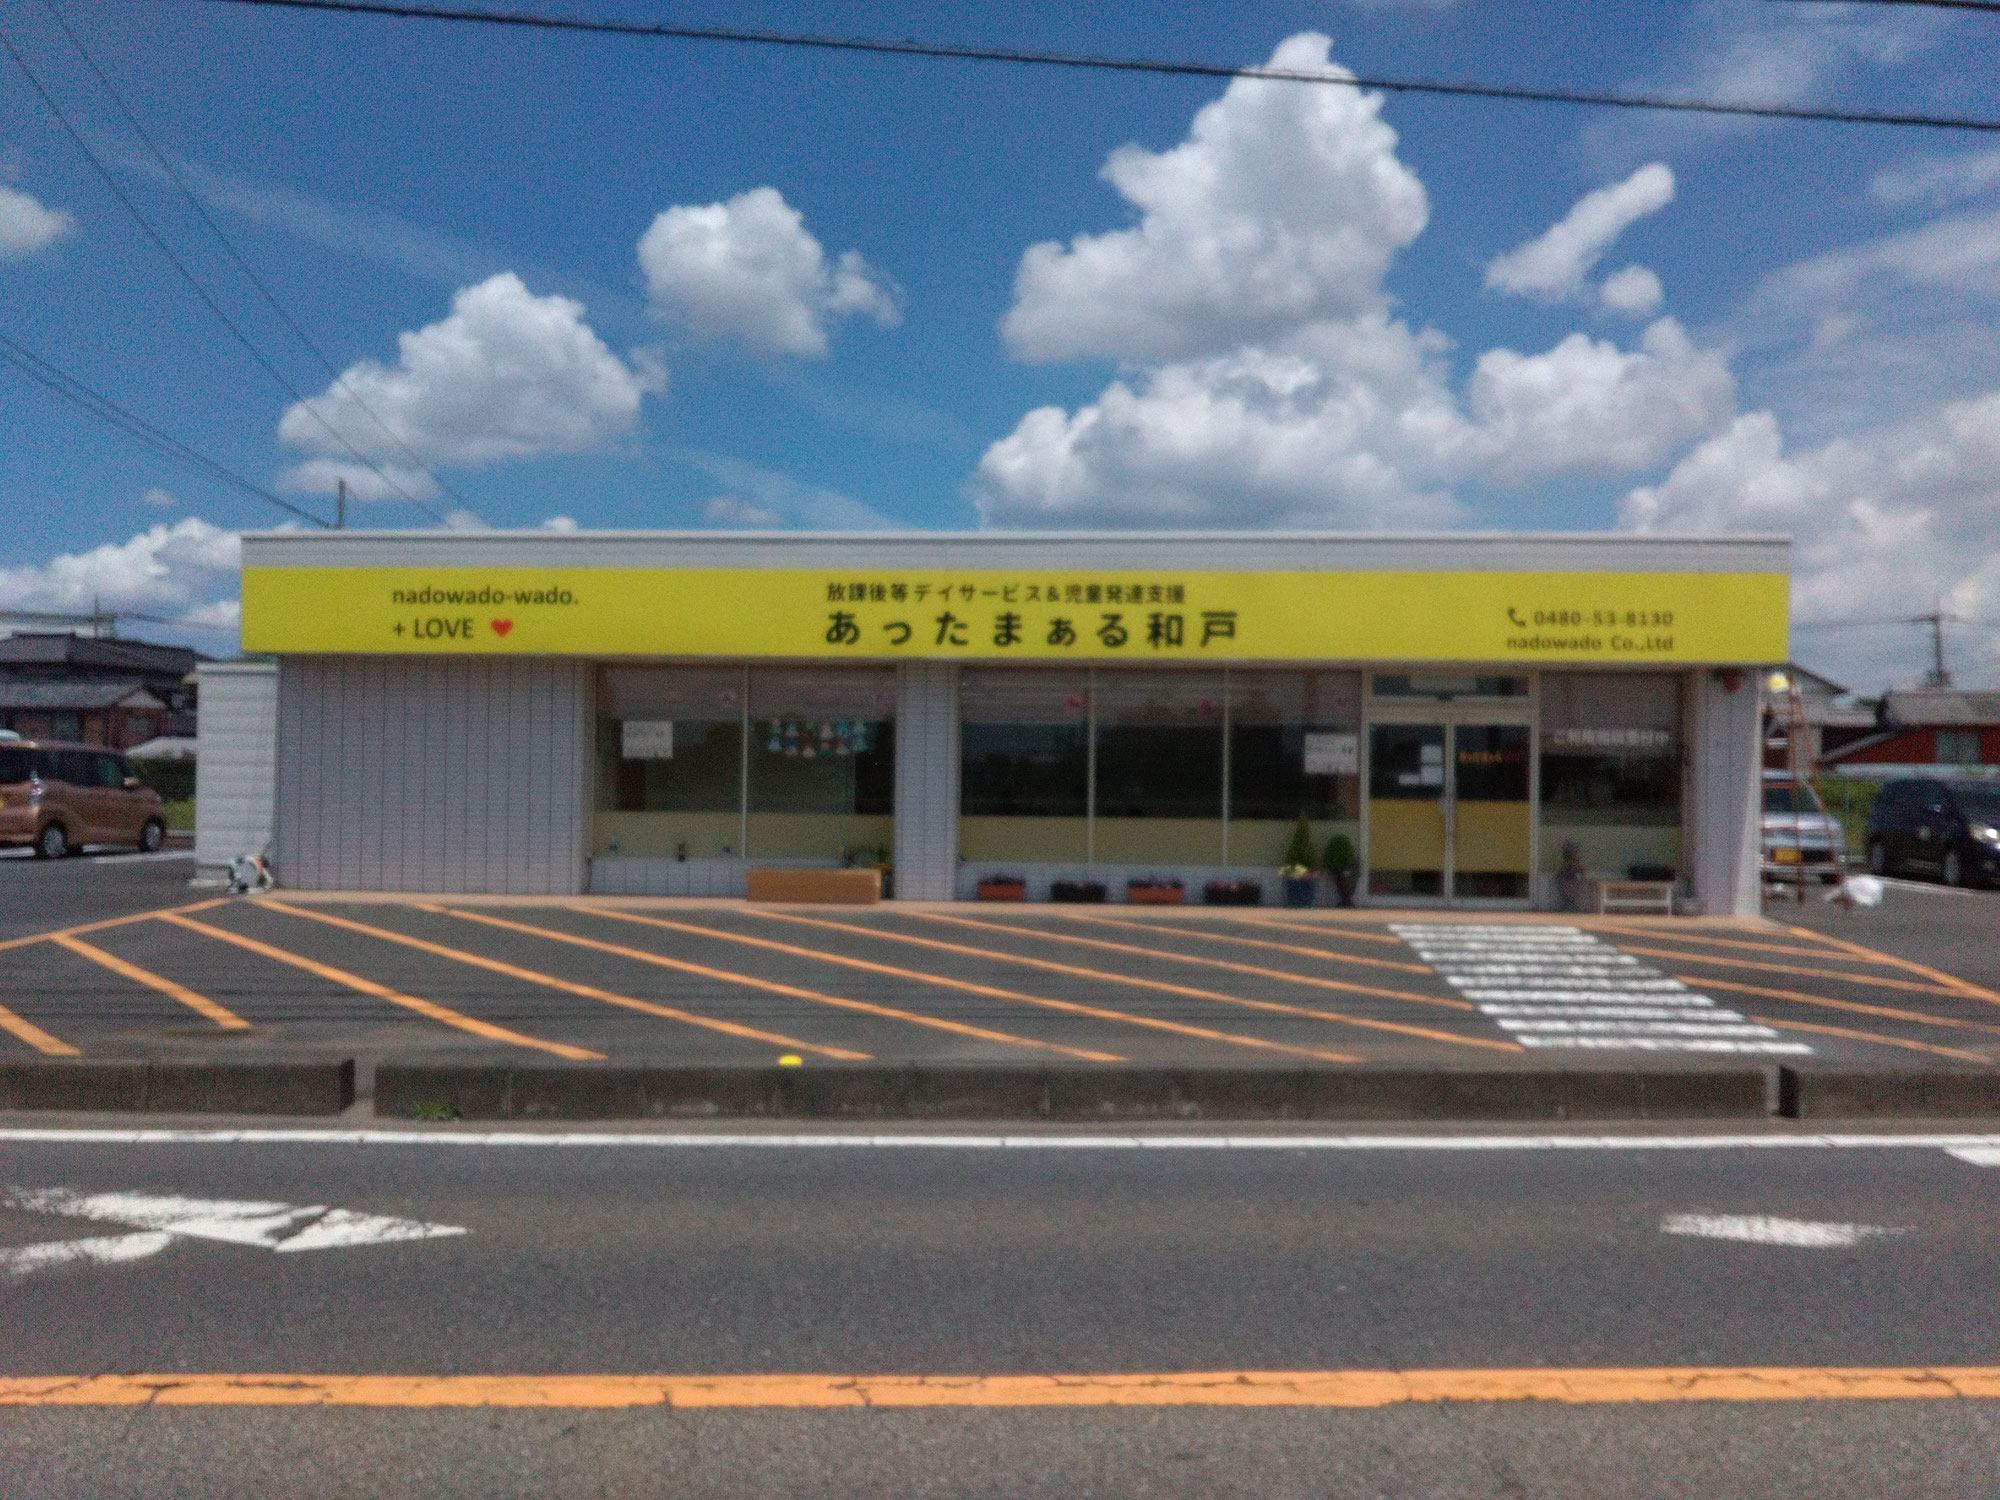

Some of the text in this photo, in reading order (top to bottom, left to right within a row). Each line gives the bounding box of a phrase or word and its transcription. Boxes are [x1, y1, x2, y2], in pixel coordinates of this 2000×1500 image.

[393, 585, 578, 605] nadowado-wado.
[414, 618, 474, 639] LOVE
[825, 611, 1238, 648] あったまぁる和戸
[1507, 634, 1602, 650] nadowado
